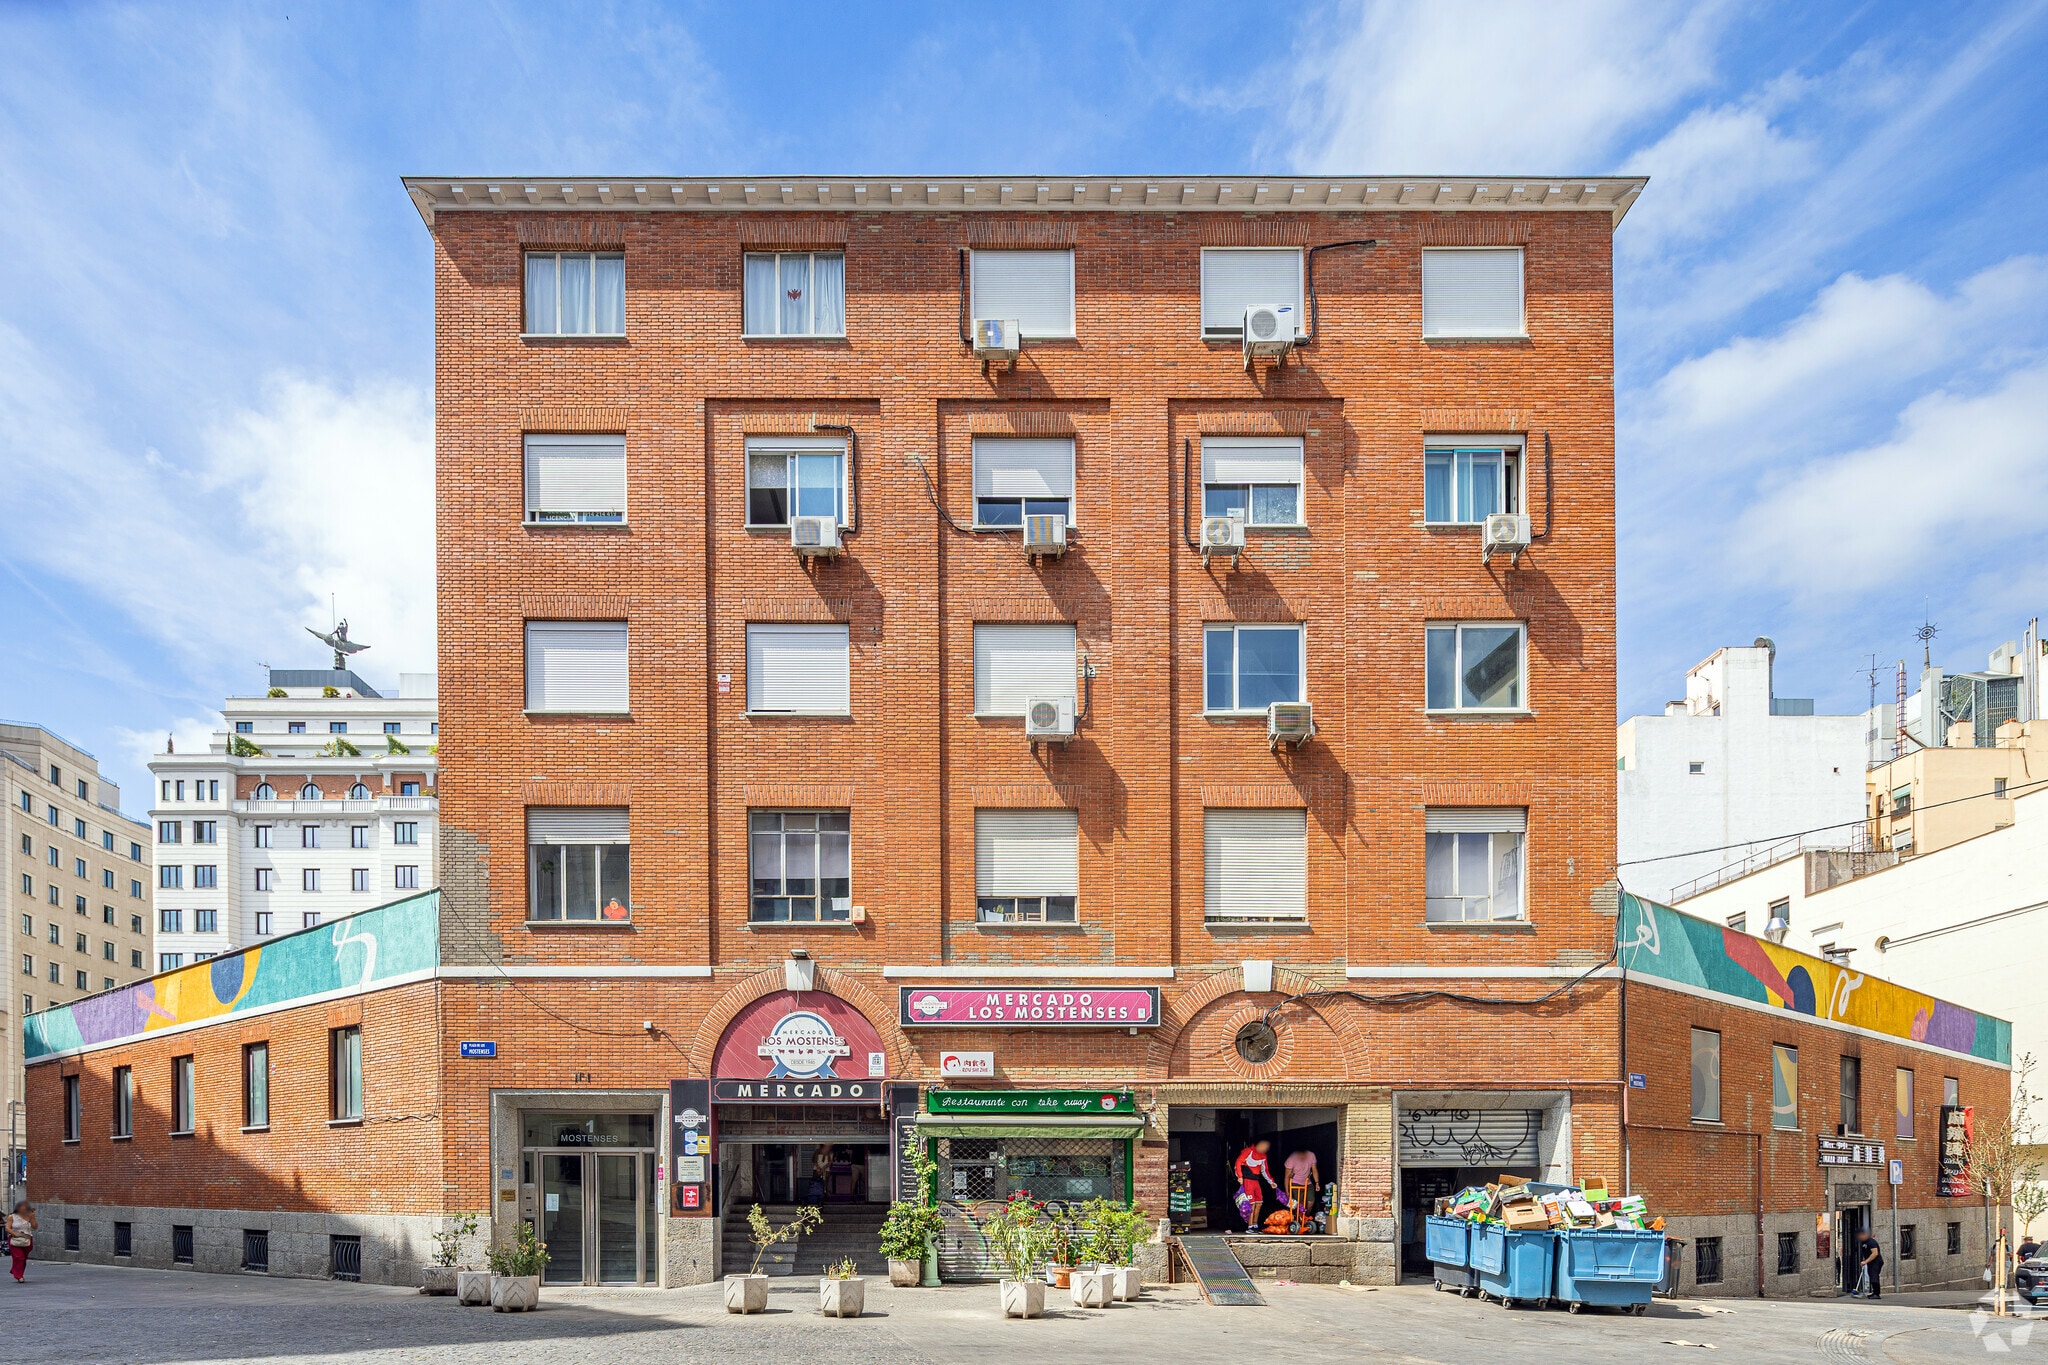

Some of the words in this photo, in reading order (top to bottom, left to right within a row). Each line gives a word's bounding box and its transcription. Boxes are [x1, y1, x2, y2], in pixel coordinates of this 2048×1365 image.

[985, 993, 1093, 1006] MERCADO
[968, 1007, 1005, 1019] LOS
[1013, 1007, 1129, 1019] MOSTENSES
[762, 1036, 782, 1046] LOS
[786, 1036, 846, 1046] MOSTENSES
[737, 1084, 863, 1098] MERCADO
[941, 1096, 1006, 1107] Restaurante
[1012, 1099, 1028, 1107] con
[1038, 1097, 1059, 1107] take
[1064, 1099, 1093, 1110] away
[585, 1119, 594, 1133] 1
[560, 1134, 619, 1143] MOSTENSES
